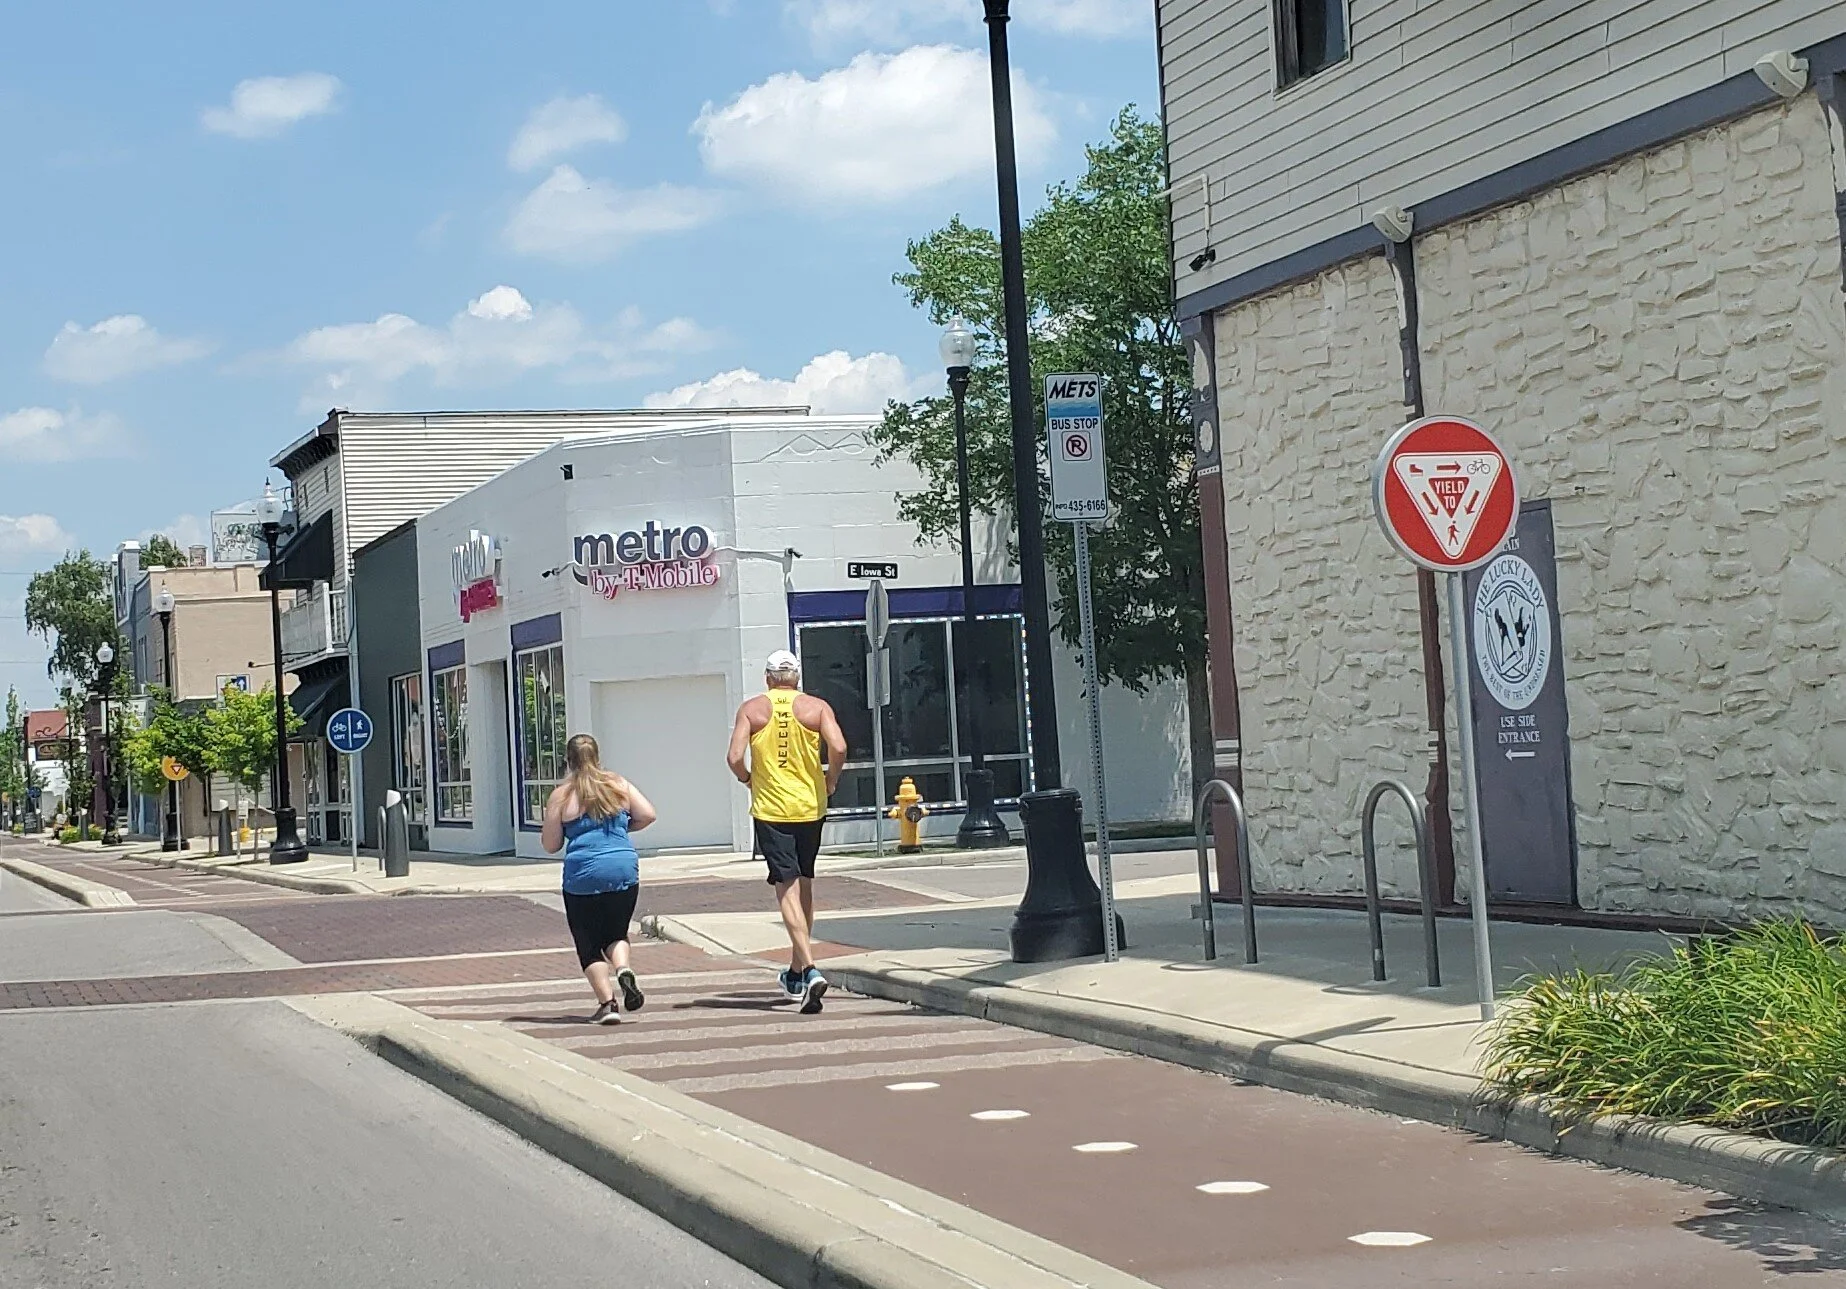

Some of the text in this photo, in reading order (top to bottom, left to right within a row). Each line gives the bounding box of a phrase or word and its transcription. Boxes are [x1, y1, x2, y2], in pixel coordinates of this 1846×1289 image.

[1049, 380, 1097, 399] METS
[1051, 418, 1098, 430] BUS STOP
[1434, 480, 1465, 494] YIELD
[1444, 496, 1456, 509] TO
[573, 520, 711, 566] metro
[850, 564, 896, 577] E Iowa St
[591, 569, 619, 600] by
[1476, 559, 1545, 615] THE LUCKY LADY
[1500, 714, 1536, 728] USE SIDE
[1498, 730, 1541, 744] ENTRANCE
